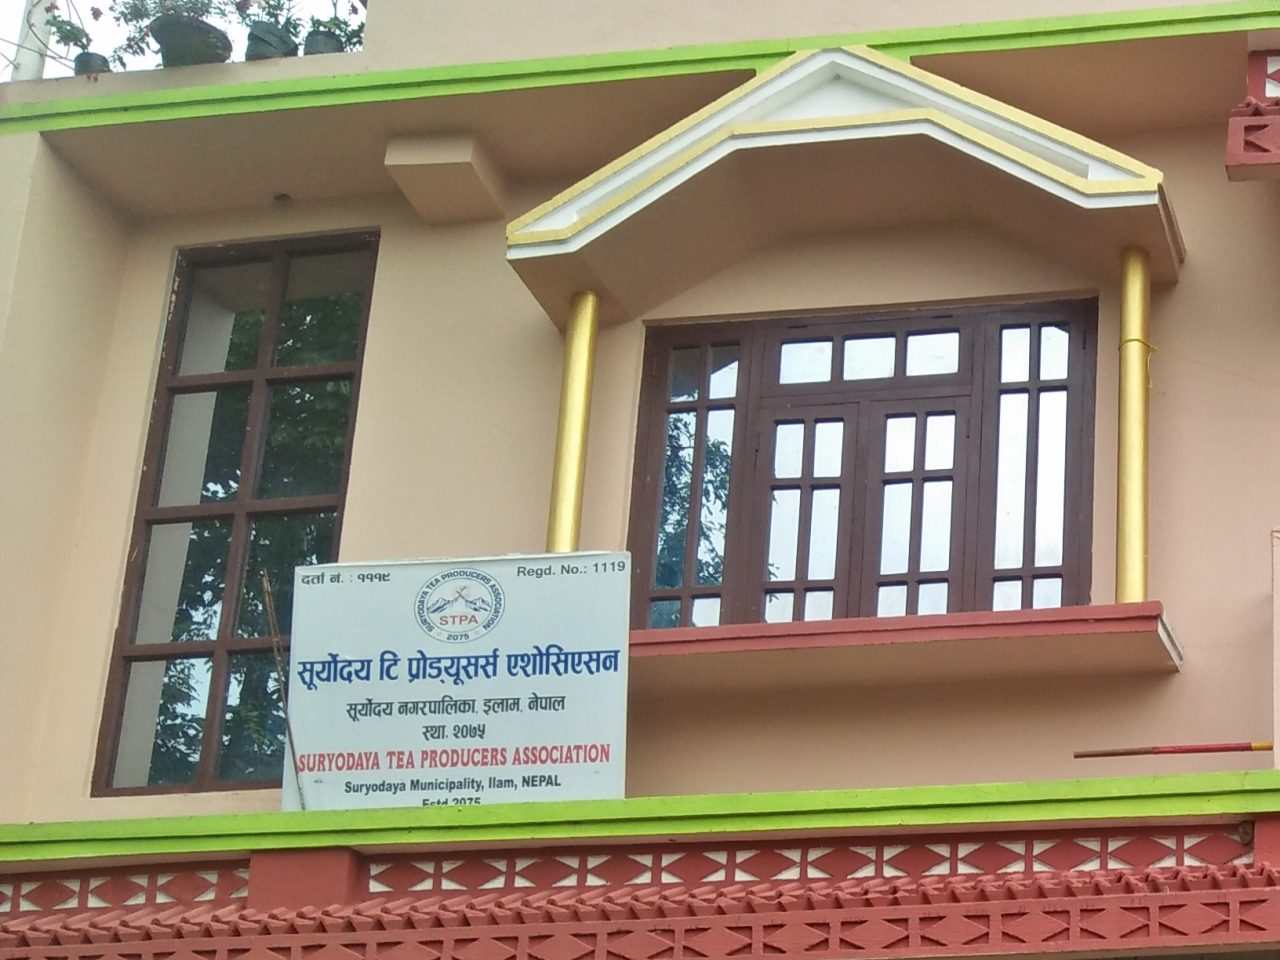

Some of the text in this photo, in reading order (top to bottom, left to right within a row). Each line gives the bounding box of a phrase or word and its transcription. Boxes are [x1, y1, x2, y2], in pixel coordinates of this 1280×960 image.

[301, 571, 325, 585] दर्ता
[517, 561, 626, 577] Regd. No.: 1119
[417, 570, 502, 633] SURYODAYA TEA PRODUCERS ASSOCIATION
[439, 614, 479, 626] STPA
[446, 633, 470, 641] 2075
[297, 652, 373, 690] सूर्योदय
[379, 650, 400, 681] टि
[506, 644, 621, 678] एशोसिएसन
[346, 698, 394, 722] सूर्योदय
[528, 692, 566, 712] नेपाल
[453, 723, 486, 740] २०७५
[298, 744, 611, 773] SURYODAYA TEA PRODUCERS ASSOCIATION
[345, 774, 561, 795] Suryodaya Municipality, Ilam, NEPAL
